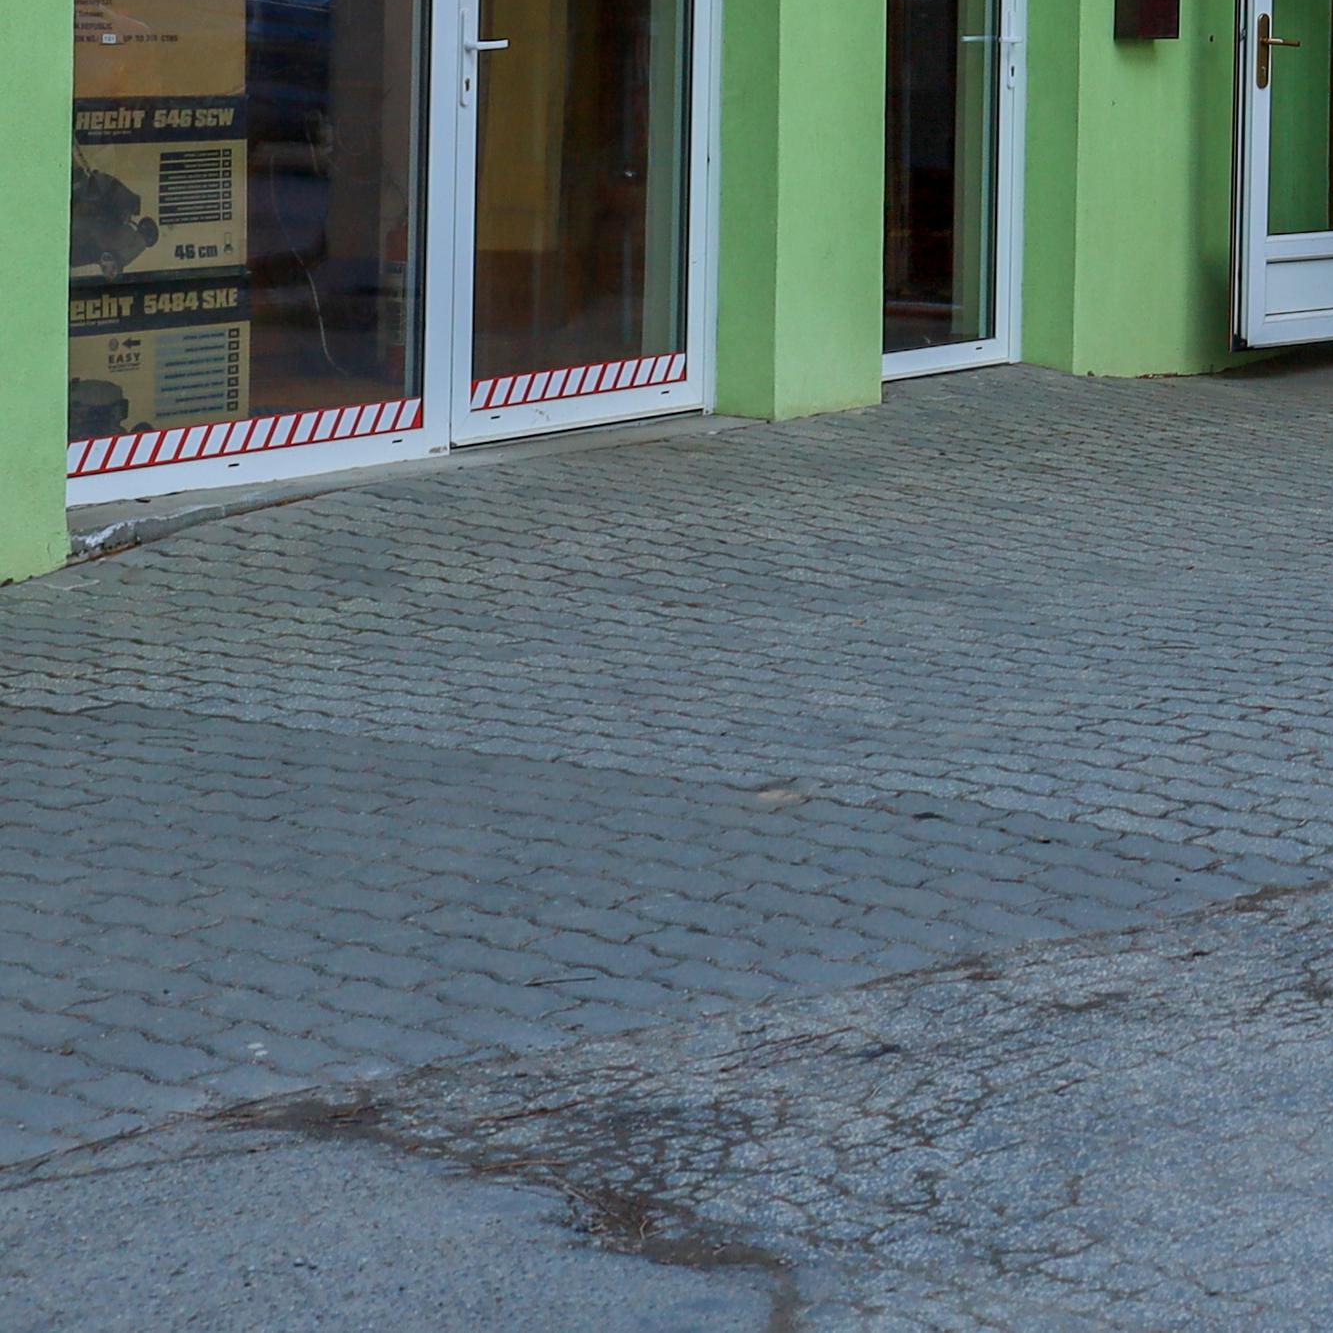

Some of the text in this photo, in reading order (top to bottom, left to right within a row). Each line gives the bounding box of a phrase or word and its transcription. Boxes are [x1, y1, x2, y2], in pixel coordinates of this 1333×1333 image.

[154, 108, 193, 129] 546
[174, 244, 218, 260] 46 cm
[143, 290, 199, 315] 5484
[108, 352, 142, 364] EASY
